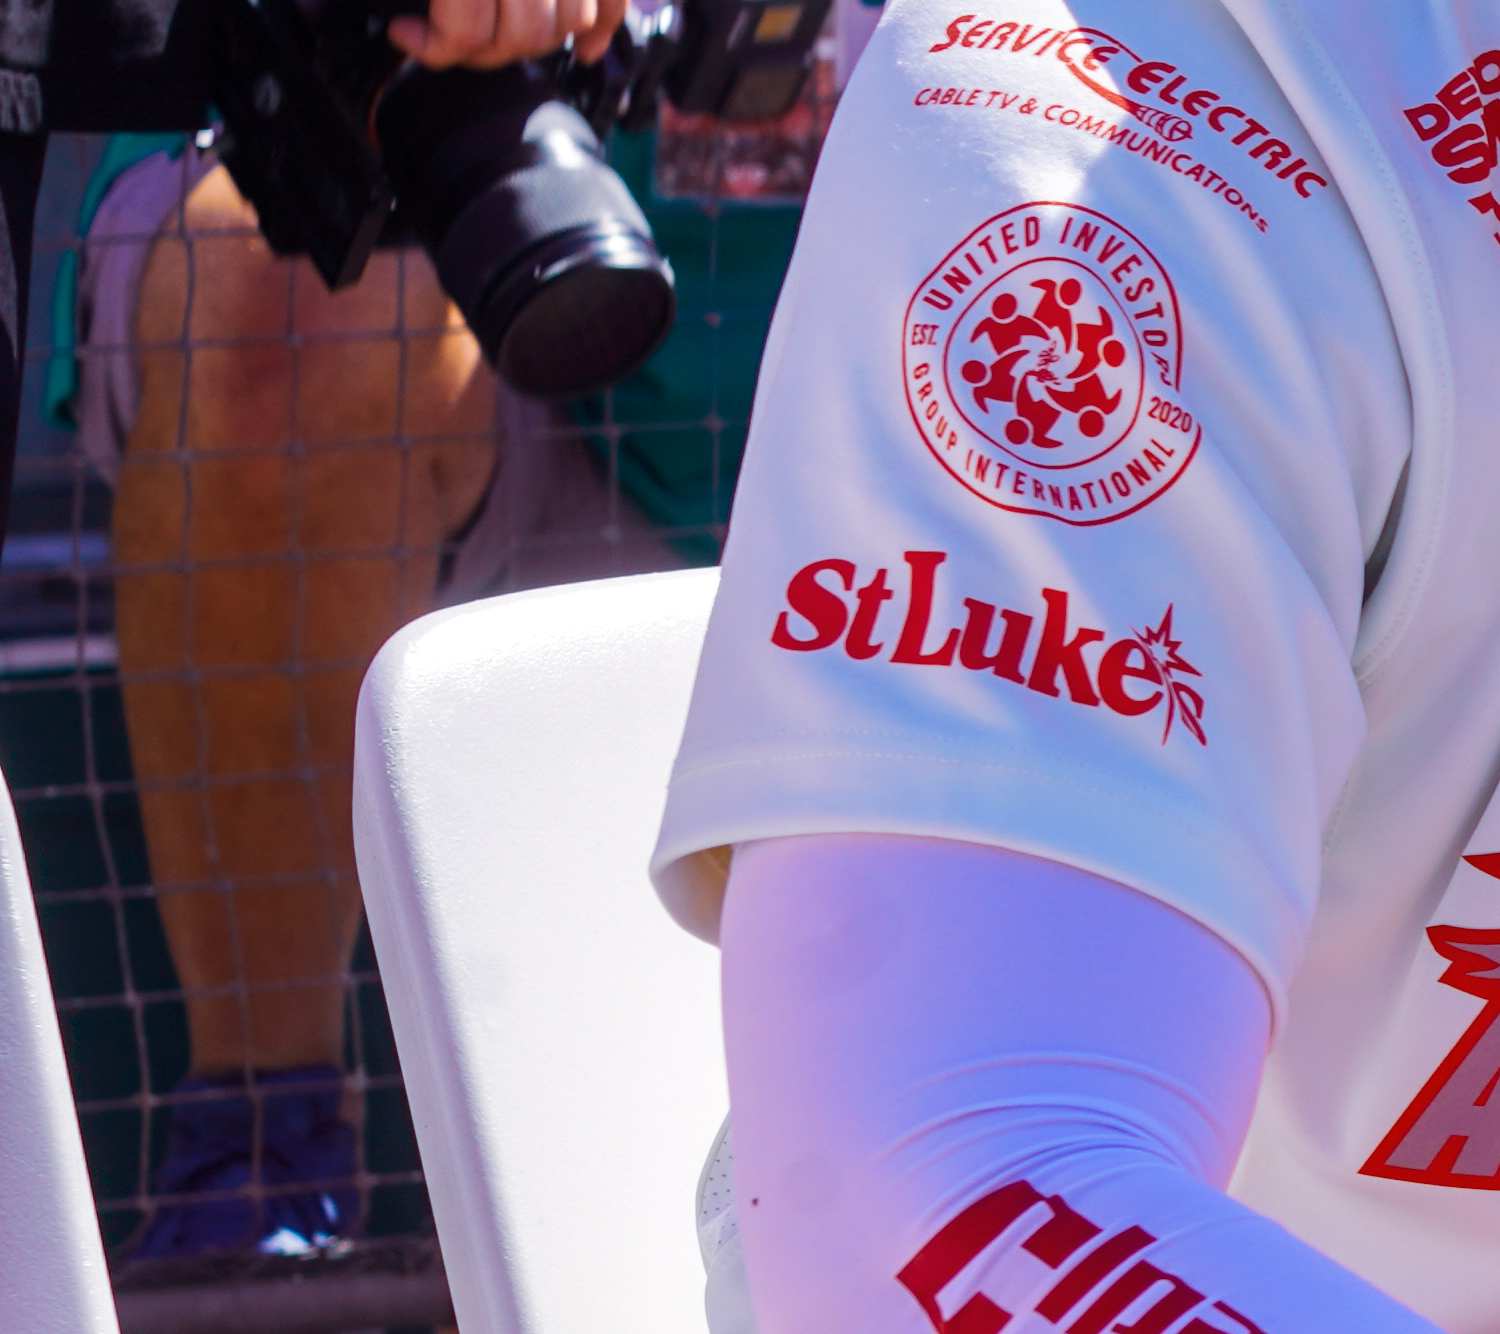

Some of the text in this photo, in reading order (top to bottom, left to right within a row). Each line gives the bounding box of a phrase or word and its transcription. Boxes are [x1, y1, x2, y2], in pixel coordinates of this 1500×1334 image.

[912, 86, 1270, 234] CABLE TV & COMMUNICATIONS
[928, 12, 1329, 200] SERVICE ELECTRIC
[922, 215, 1041, 312] UNITED
[912, 361, 1177, 512] GROUP INTERNATIONAL
[1146, 395, 1194, 435] 2020
